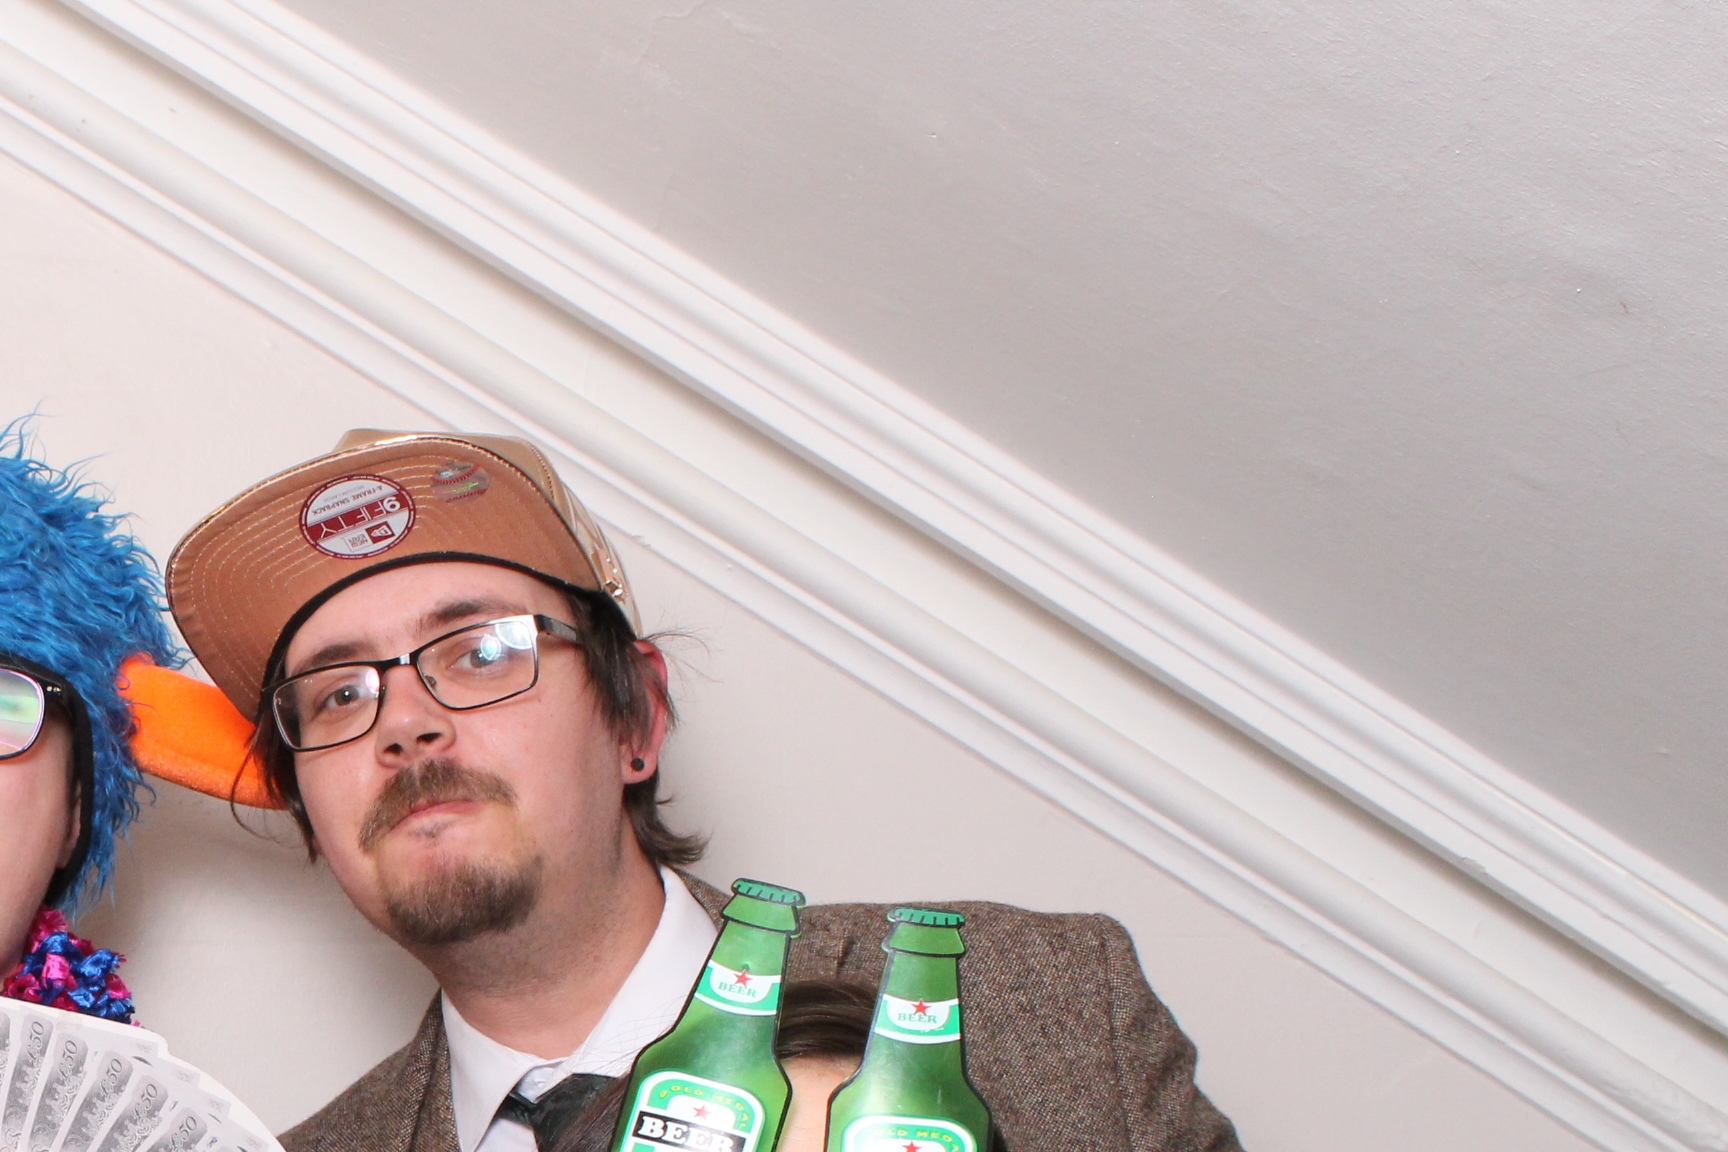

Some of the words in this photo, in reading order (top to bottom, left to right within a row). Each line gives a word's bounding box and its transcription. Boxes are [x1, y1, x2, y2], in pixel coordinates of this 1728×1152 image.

[312, 497, 351, 516] SNAPBACK
[352, 485, 383, 500] A-FRAME
[320, 496, 401, 539] 9FIFTY
[716, 980, 757, 998] BEER
[897, 1011, 937, 1025] BEER
[26, 1021, 45, 1062] £50
[58, 1040, 78, 1080] £50
[100, 1058, 123, 1098] £50
[133, 1083, 158, 1120] £50
[170, 1116, 198, 1152] £50
